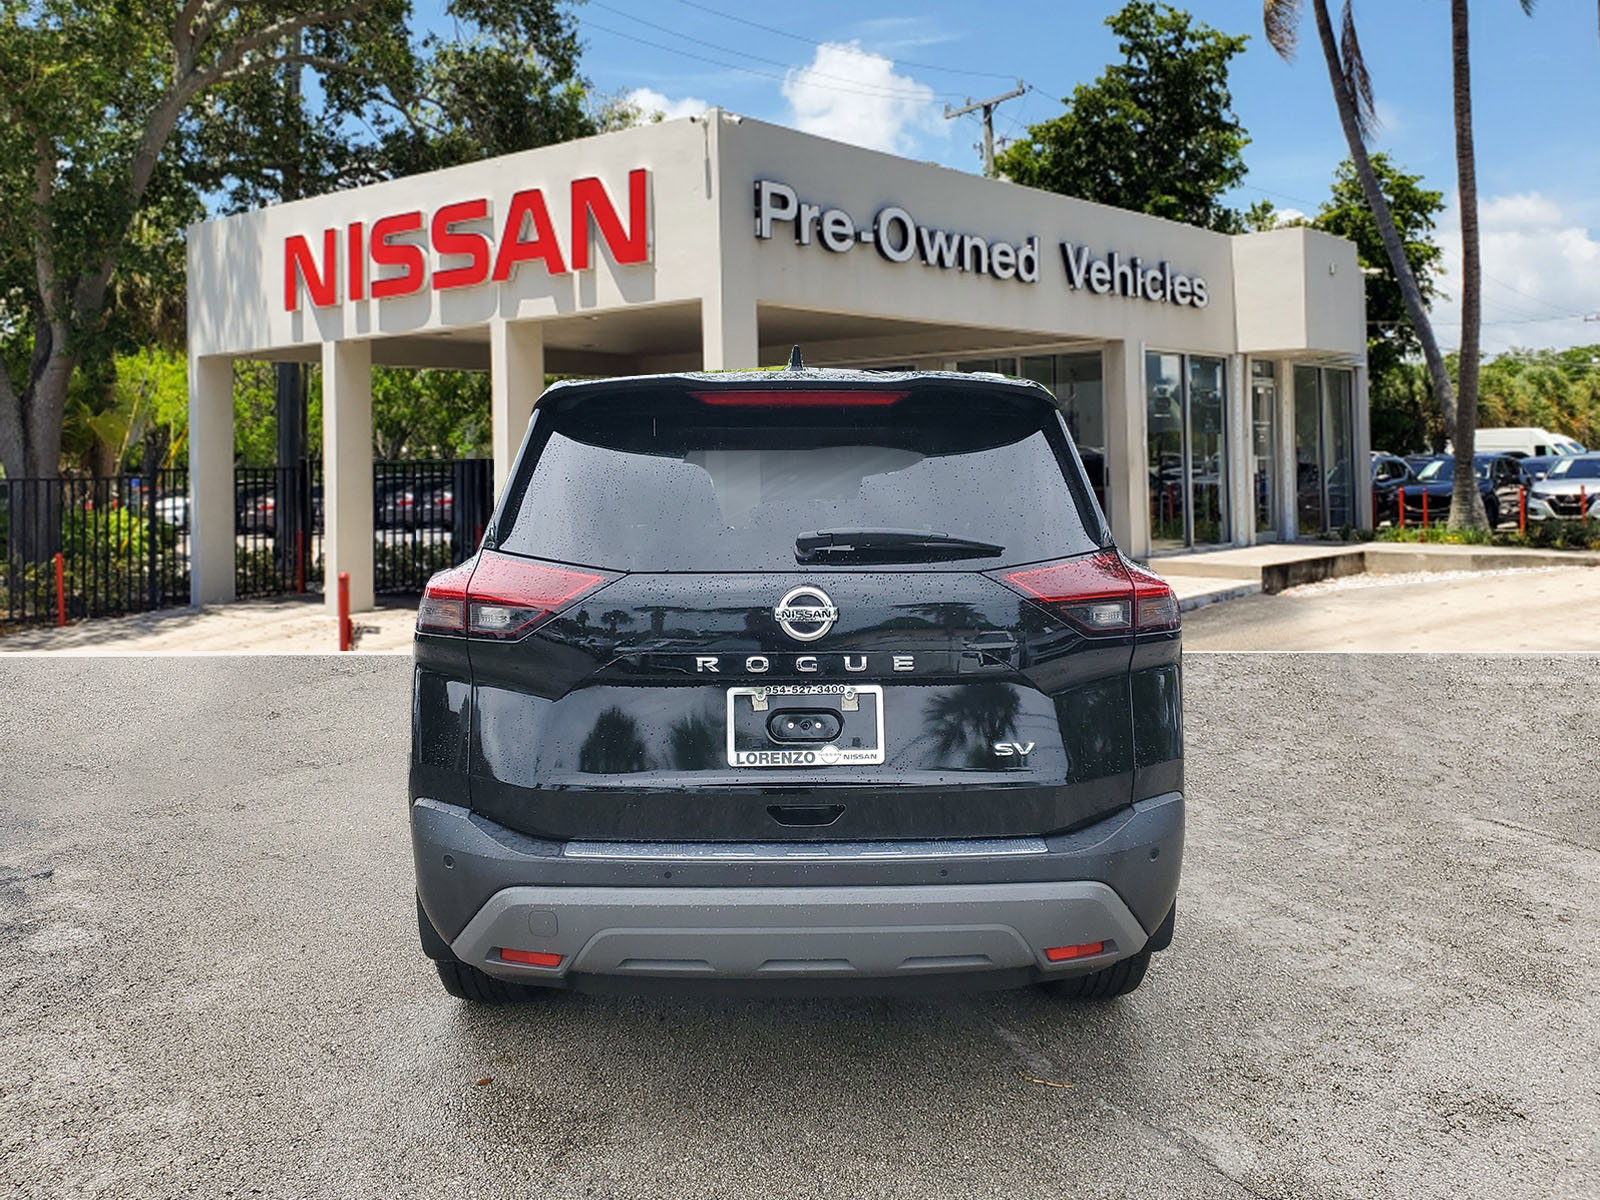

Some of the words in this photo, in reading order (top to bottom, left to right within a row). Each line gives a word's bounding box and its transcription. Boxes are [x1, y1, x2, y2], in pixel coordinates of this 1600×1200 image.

[285, 168, 648, 312] NISSAN
[754, 180, 1040, 283] Pre-Owned
[1060, 242, 1208, 308] Vehicles
[781, 610, 832, 618] NISSAN
[695, 655, 916, 673] ROGUE
[764, 685, 846, 695] 954-527-3400
[994, 742, 1035, 756] SV
[736, 752, 816, 765] LORENZO
